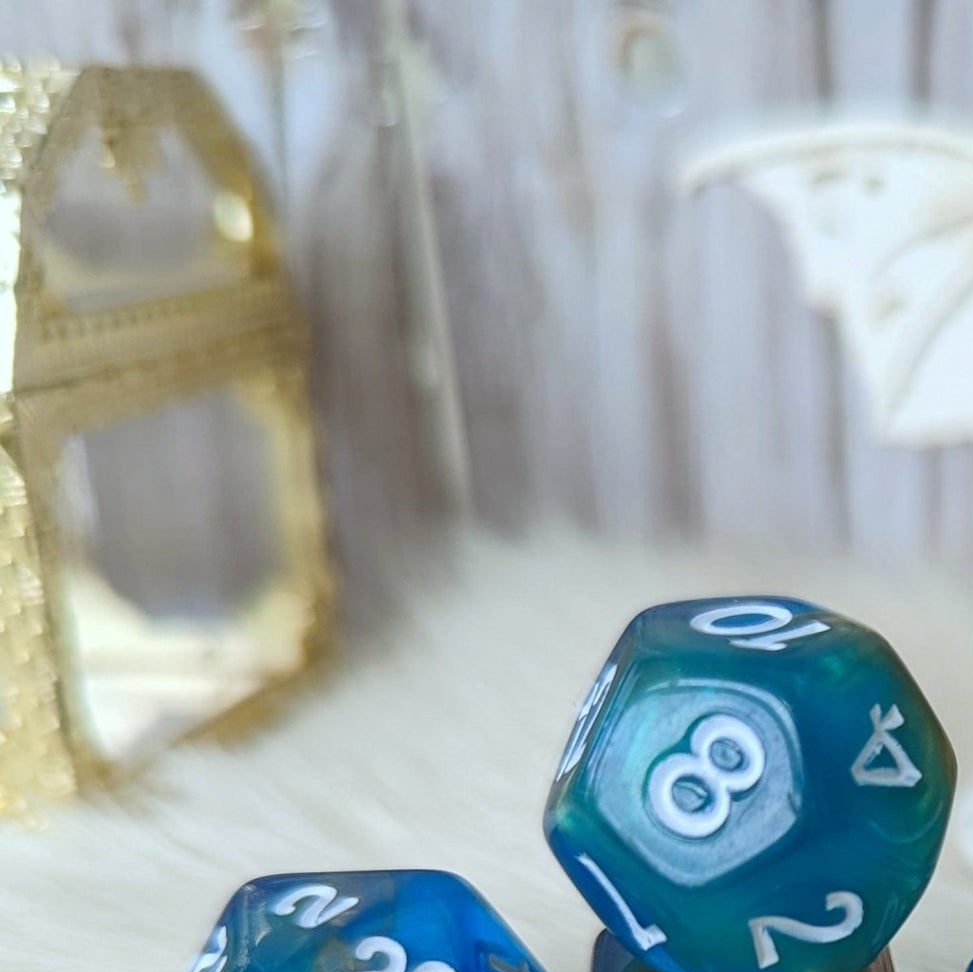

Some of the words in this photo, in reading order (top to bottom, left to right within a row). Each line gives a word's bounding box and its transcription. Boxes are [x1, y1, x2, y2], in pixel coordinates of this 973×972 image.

[689, 605, 832, 651] 10
[648, 712, 767, 838] 8
[849, 703, 923, 788] 4
[271, 885, 359, 929] 2
[748, 891, 864, 969] 2
